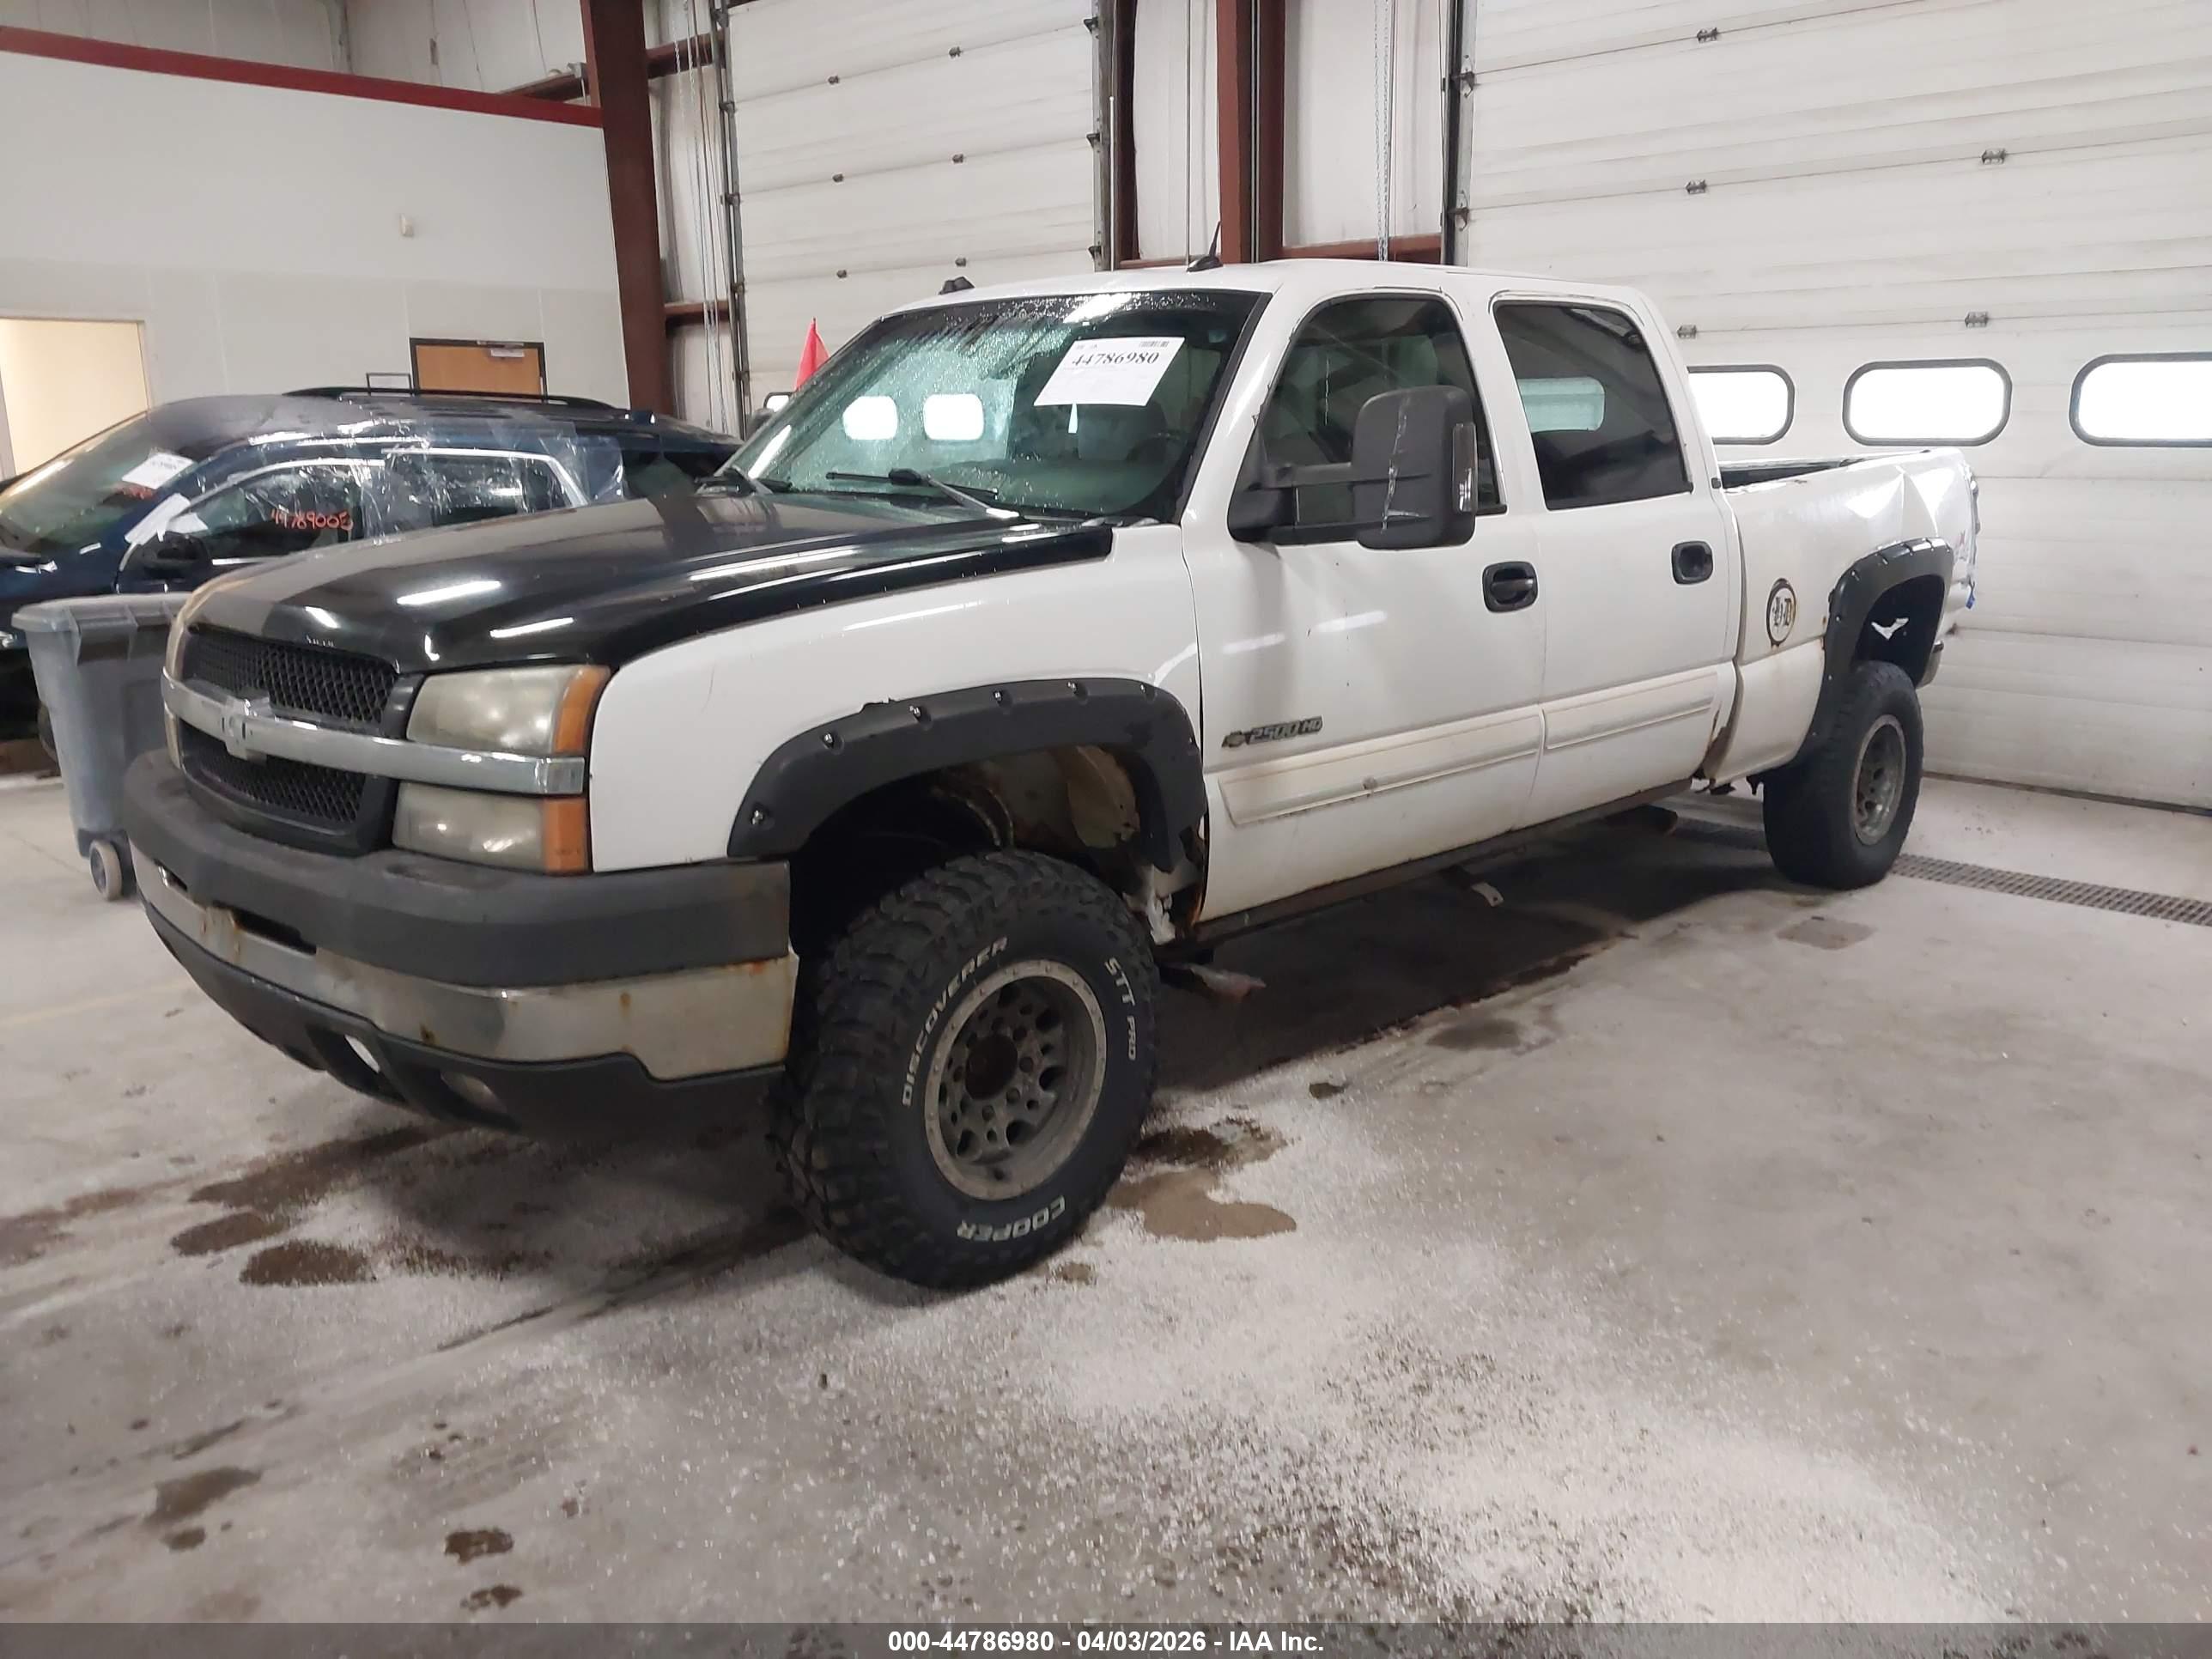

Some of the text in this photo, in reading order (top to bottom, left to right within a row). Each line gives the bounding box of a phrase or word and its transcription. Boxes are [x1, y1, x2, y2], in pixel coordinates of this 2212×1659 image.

[1073, 352, 1159, 366] 44786980
[1248, 716, 1324, 745] 2500 HD
[902, 937, 1007, 1107] DISCOVERER
[1104, 957, 1137, 1060] STT PRO
[956, 1194, 1066, 1242] COOPER
